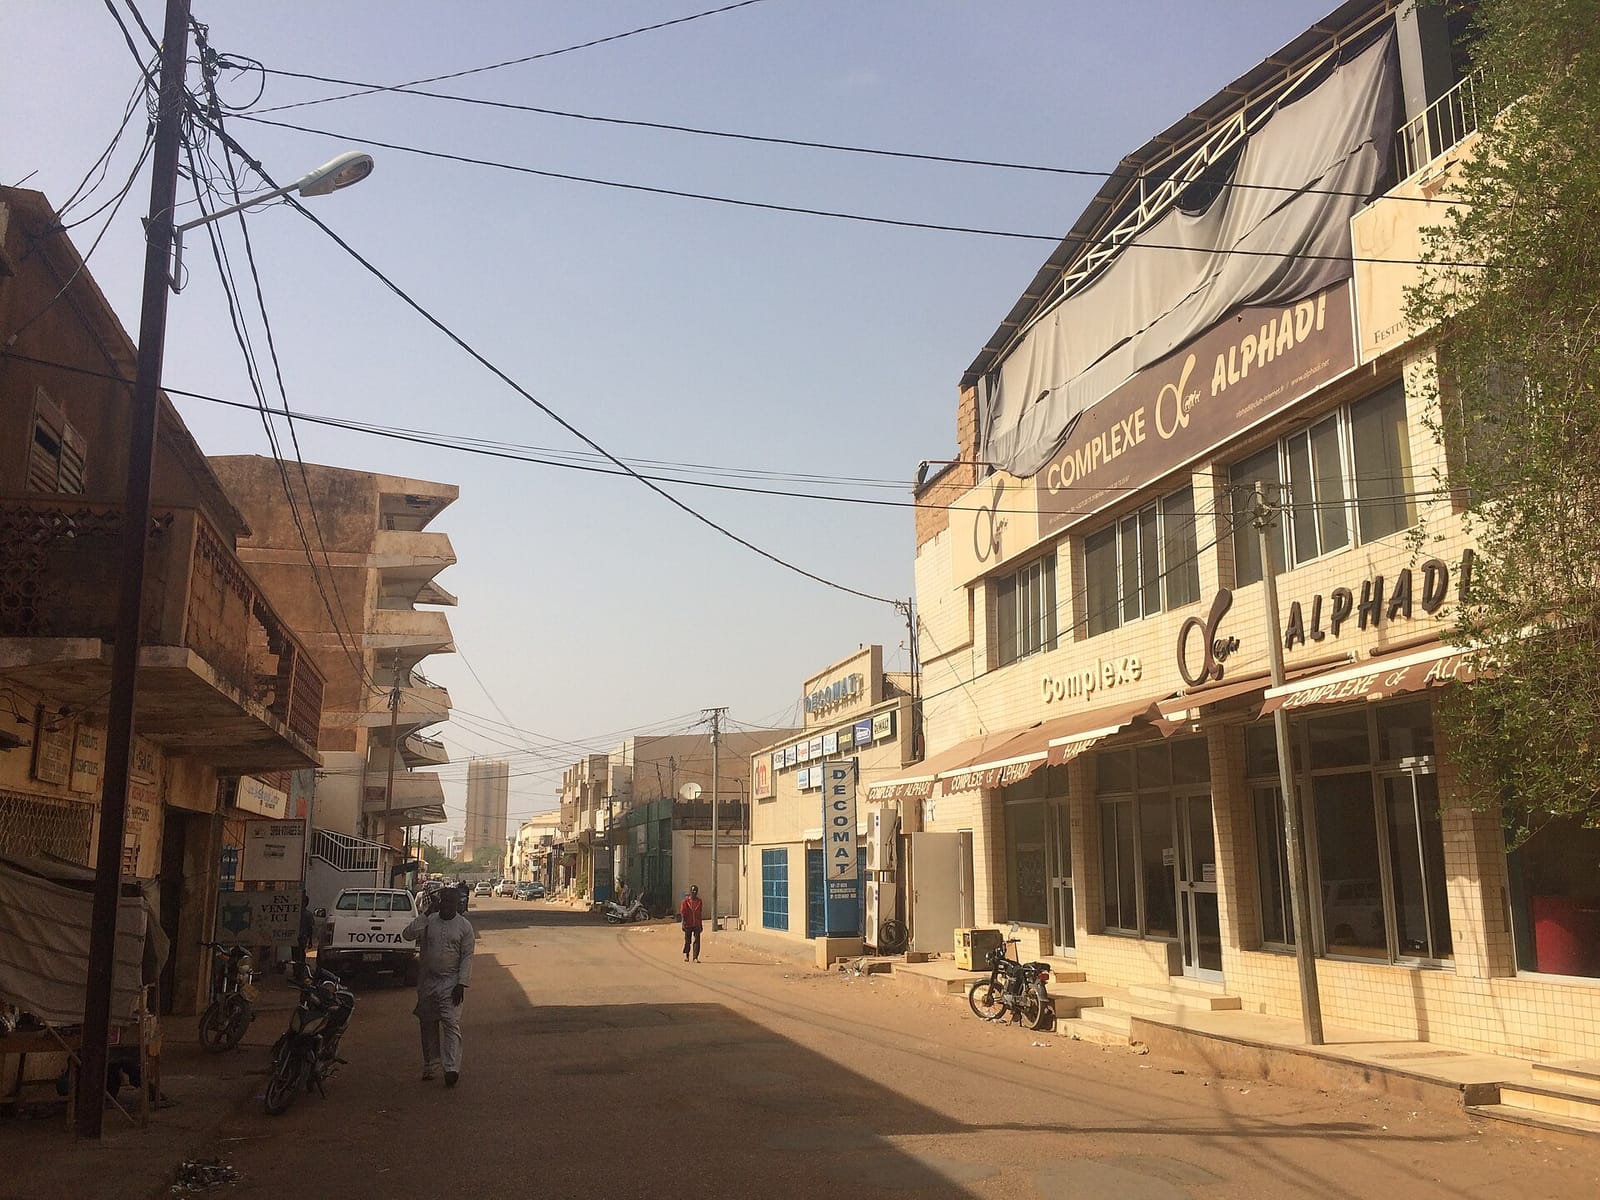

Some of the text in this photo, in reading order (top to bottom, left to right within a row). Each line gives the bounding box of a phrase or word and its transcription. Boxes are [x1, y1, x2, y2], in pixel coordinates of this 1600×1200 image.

[1047, 406, 1146, 495] COMPLEXE
[1211, 292, 1326, 396] ALPHADI
[1041, 655, 1143, 704] Complexe
[1285, 549, 1474, 651] ALPHADI
[804, 673, 859, 713] DECOMAT
[1281, 673, 1380, 707] COMPLEXE
[952, 770, 984, 791] COMPLEXE
[996, 762, 1031, 783] ALPHADI
[832, 769, 850, 874] DECOMAT
[262, 904, 299, 913] VENTE
[273, 895, 289, 904] EN
[271, 914, 288, 922] ICI
[348, 933, 402, 943] TOYOTA
